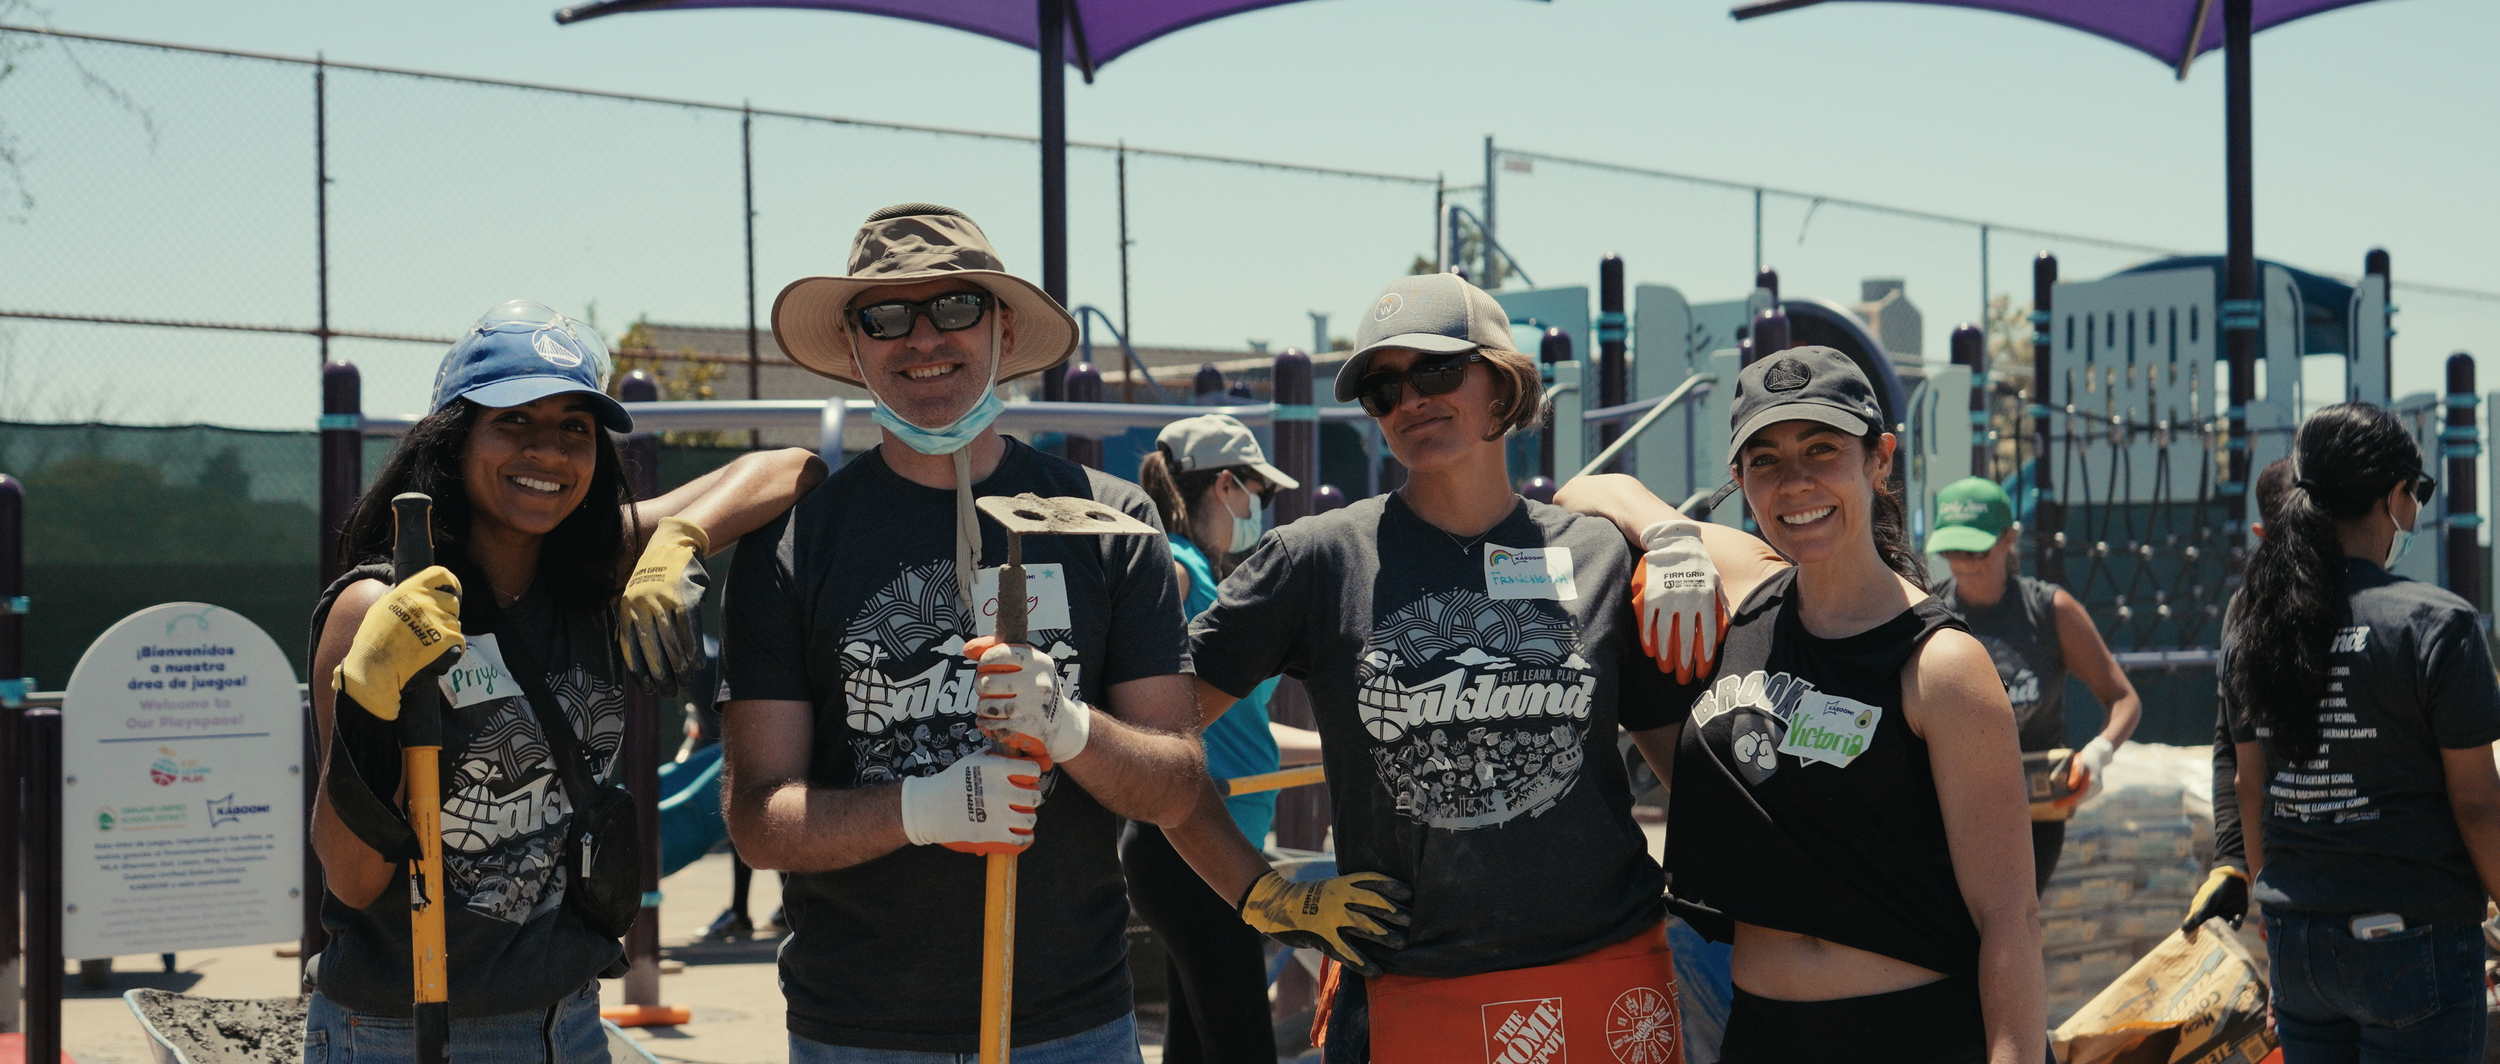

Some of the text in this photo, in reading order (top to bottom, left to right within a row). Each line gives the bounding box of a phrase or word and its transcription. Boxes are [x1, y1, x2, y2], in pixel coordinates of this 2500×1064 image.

[1664, 572, 1684, 580] FIRM
[388, 604, 411, 622] GRIP
[408, 621, 432, 646] FIRM
[166, 662, 225, 672] nuestra
[452, 664, 506, 695] Priya
[1502, 669, 1578, 683] EAT. LEARN. PLAY.
[169, 676, 187, 689] de
[192, 675, 247, 692] juegos!
[140, 698, 230, 710] Welcome to
[1357, 667, 1598, 742] Oakland
[1828, 706, 1855, 716] KABOOM!
[126, 714, 243, 729] Our Playspace!
[2334, 712, 2358, 724] SCHOOL
[1788, 712, 1864, 756] Victoria
[2350, 728, 2378, 738] CAMPUS
[1528, 752, 1546, 760] BAY
[2296, 774, 2330, 785] ELEMENTARY
[2330, 773, 2354, 784] SCHOOL
[216, 804, 270, 815] KABOOM!
[967, 794, 975, 822] FIRM
[1302, 894, 1312, 914] FIRM
[1493, 1010, 1526, 1044] THE
